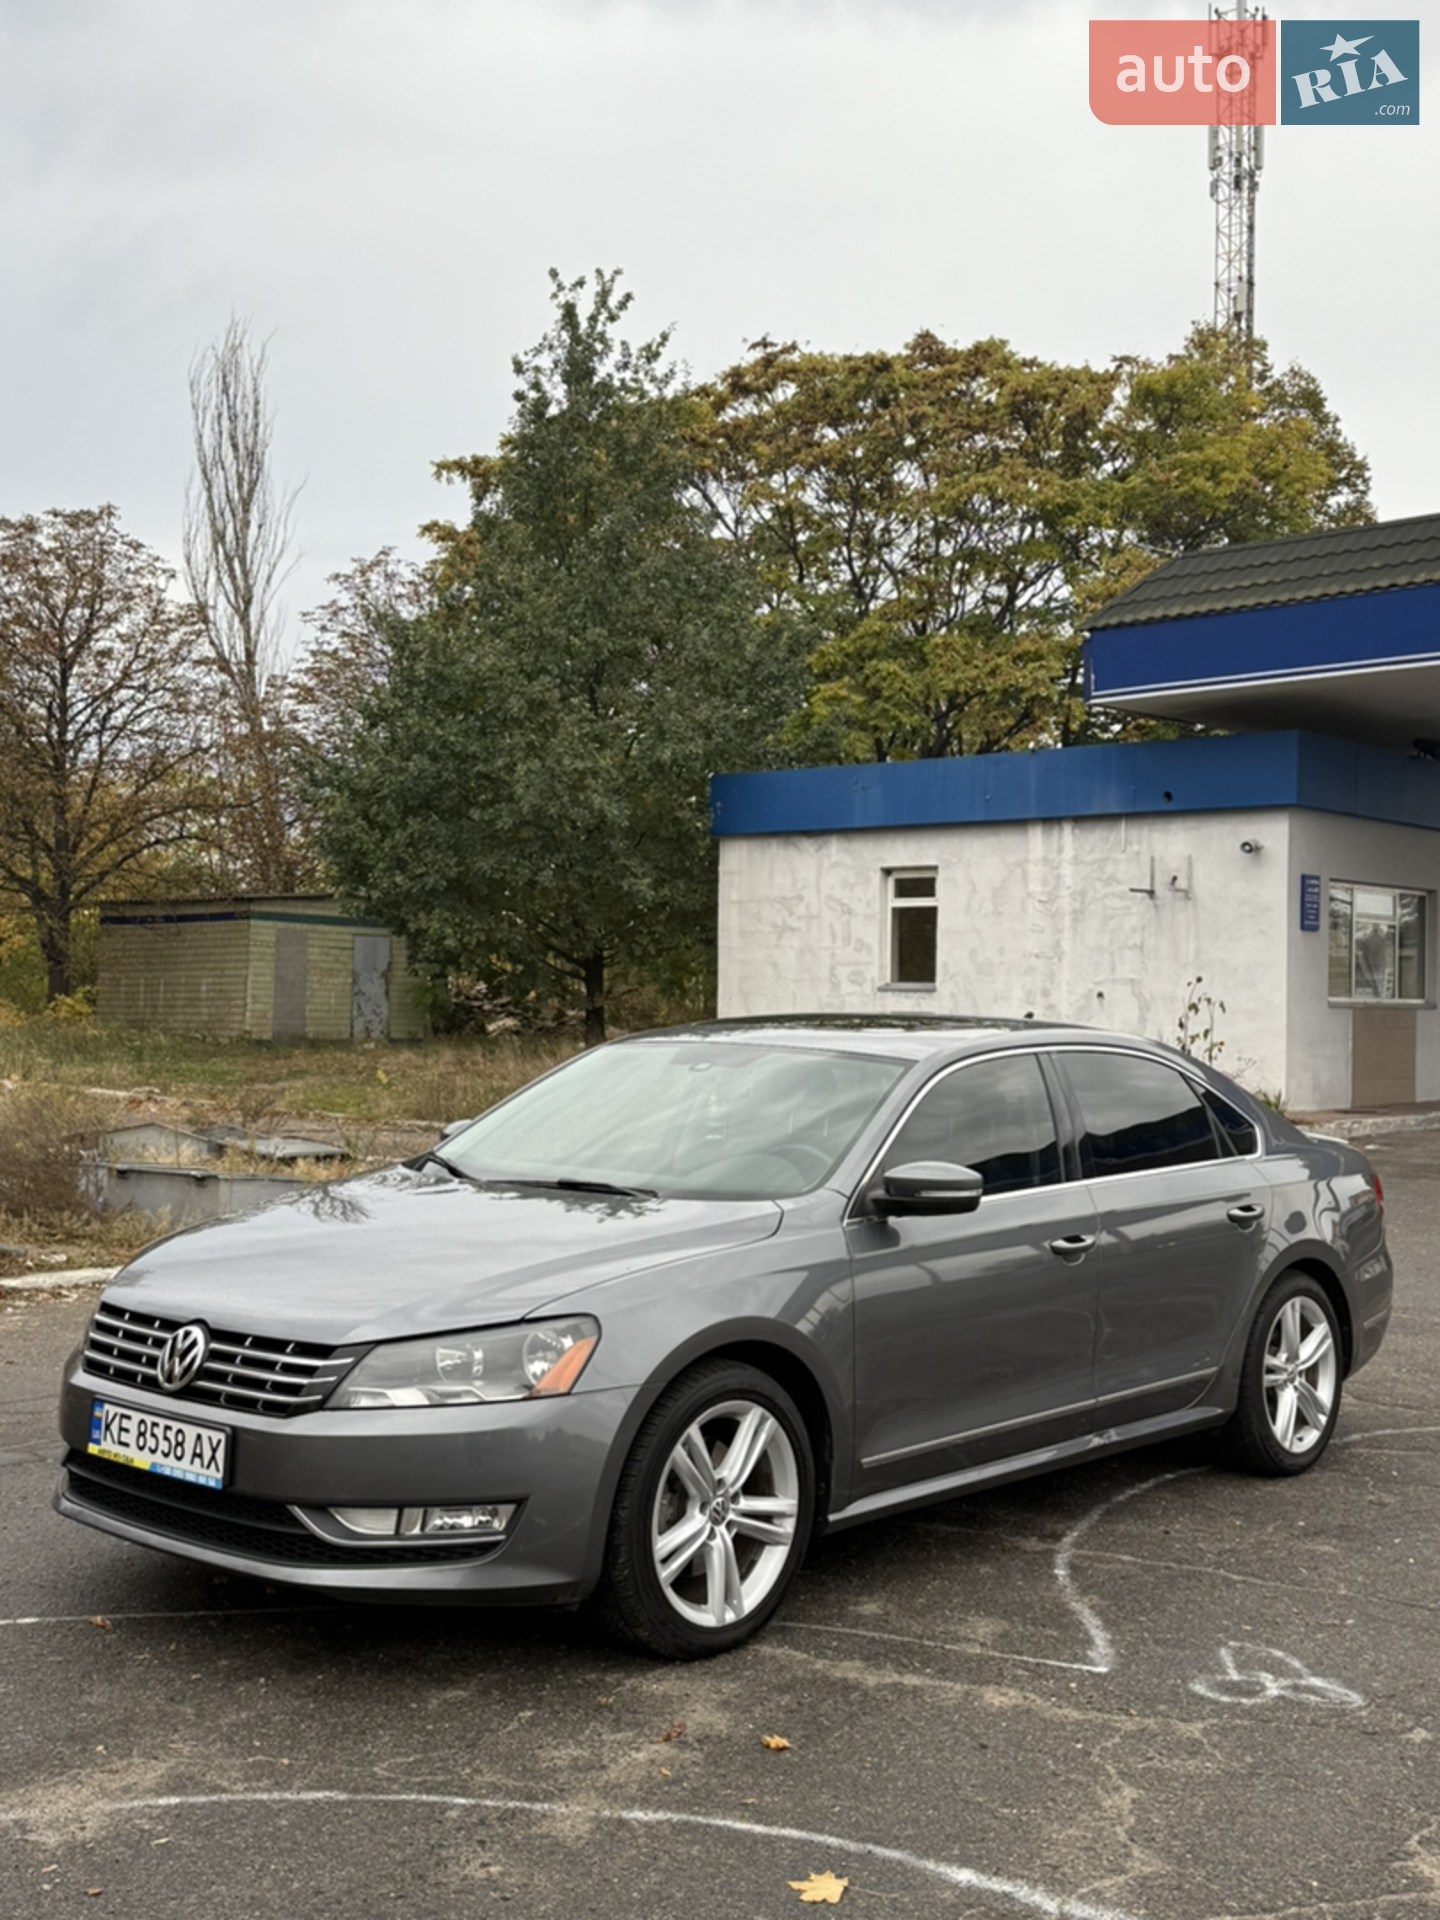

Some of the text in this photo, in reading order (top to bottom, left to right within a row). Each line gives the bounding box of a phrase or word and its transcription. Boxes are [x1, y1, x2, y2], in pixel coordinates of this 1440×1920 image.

[103, 1409, 222, 1473] KE 8558 AX
